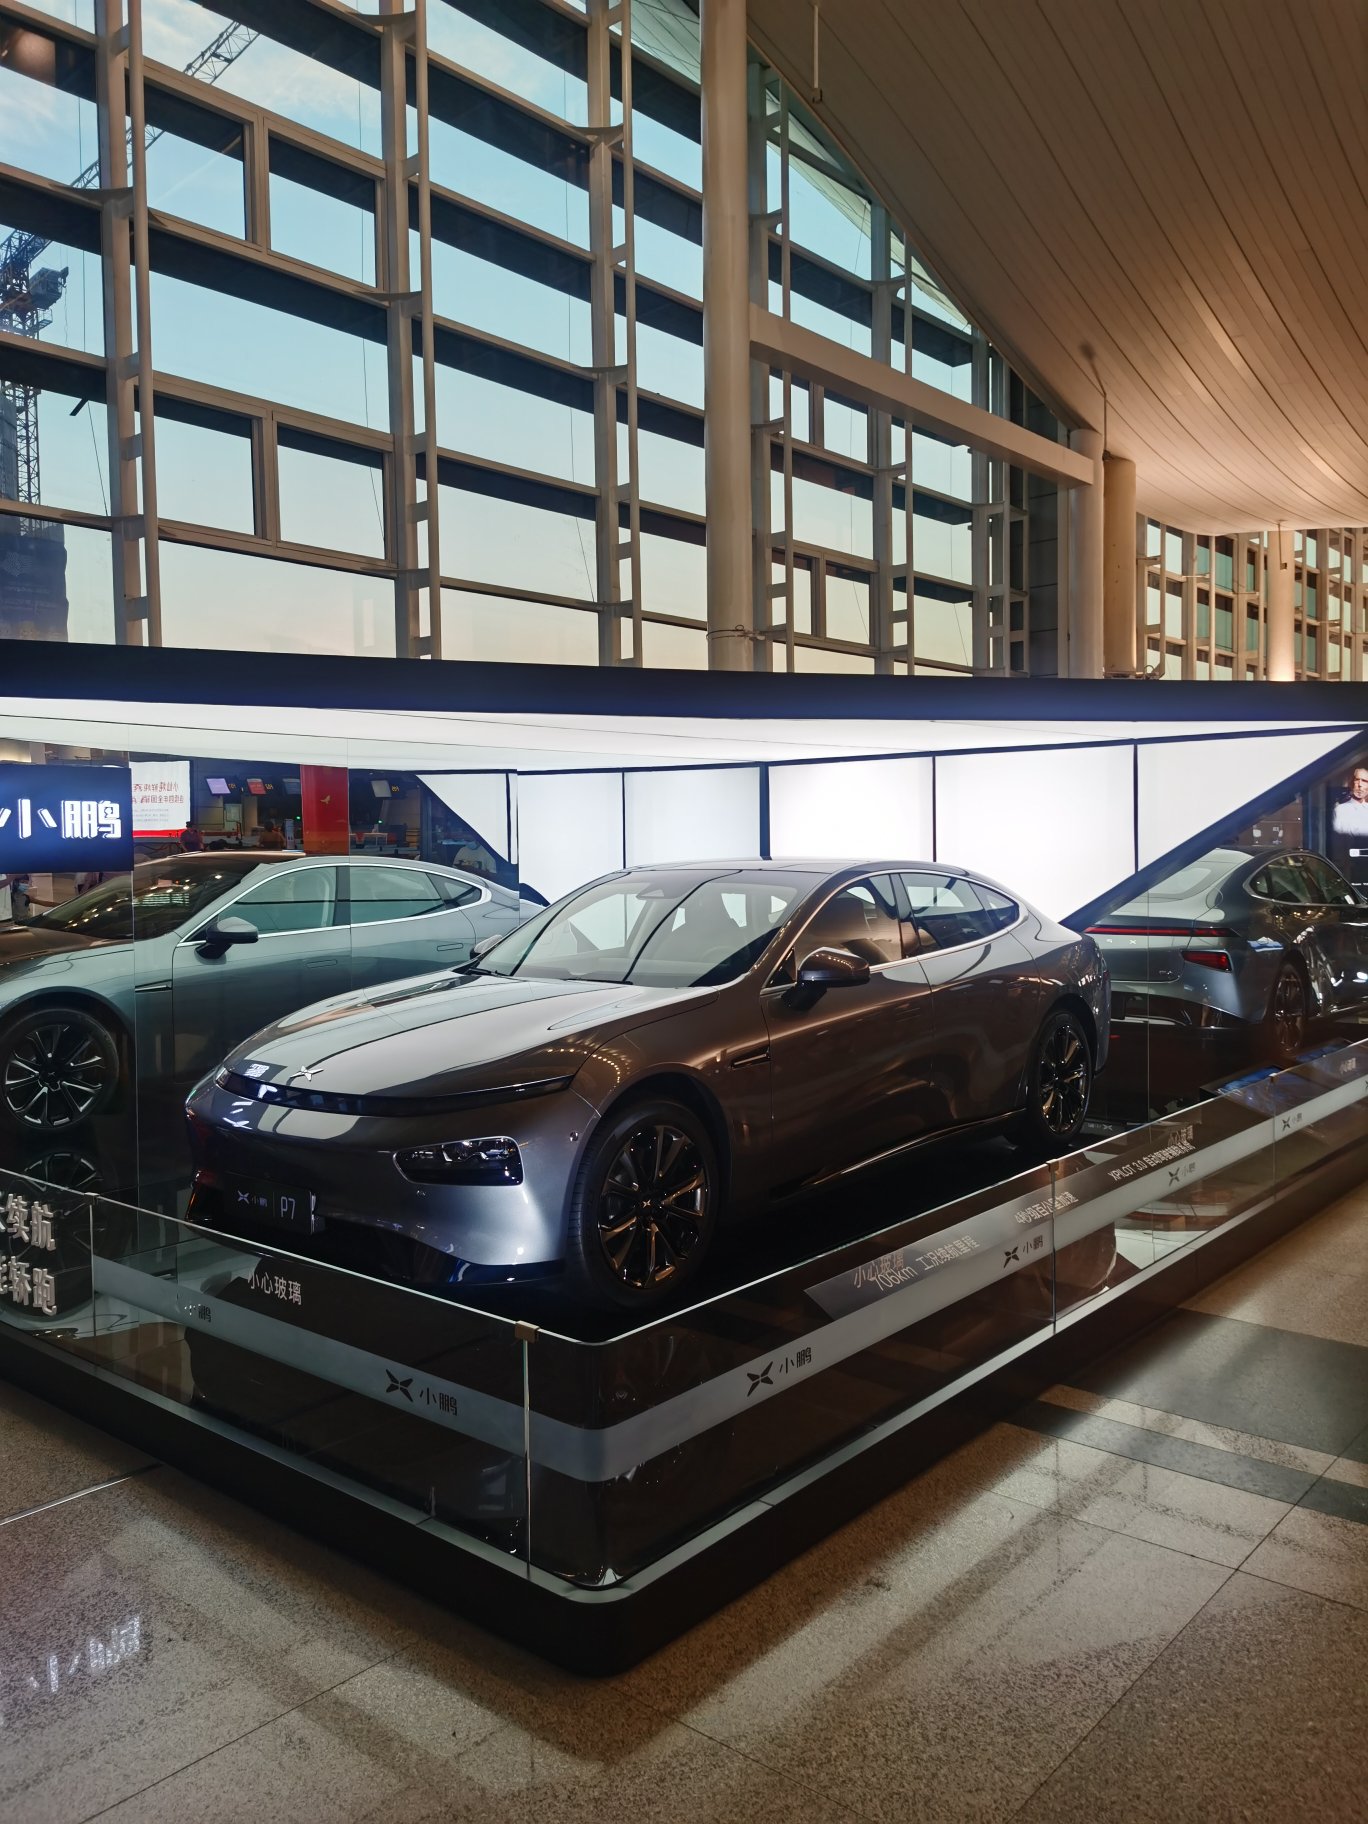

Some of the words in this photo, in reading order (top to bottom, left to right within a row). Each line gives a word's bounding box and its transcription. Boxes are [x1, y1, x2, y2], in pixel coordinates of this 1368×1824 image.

[0, 798, 122, 839] 小鹏
[1107, 1164, 1136, 1181] XPILOT
[1132, 1160, 1146, 1172] 3.0
[280, 1195, 296, 1220] P7
[0, 1193, 56, 1251] 续航
[1023, 1235, 1044, 1254] 小鹏
[248, 1272, 302, 1306] 小心玻璃
[780, 1347, 812, 1375] 小鹏
[419, 1387, 458, 1416] 小鹏
